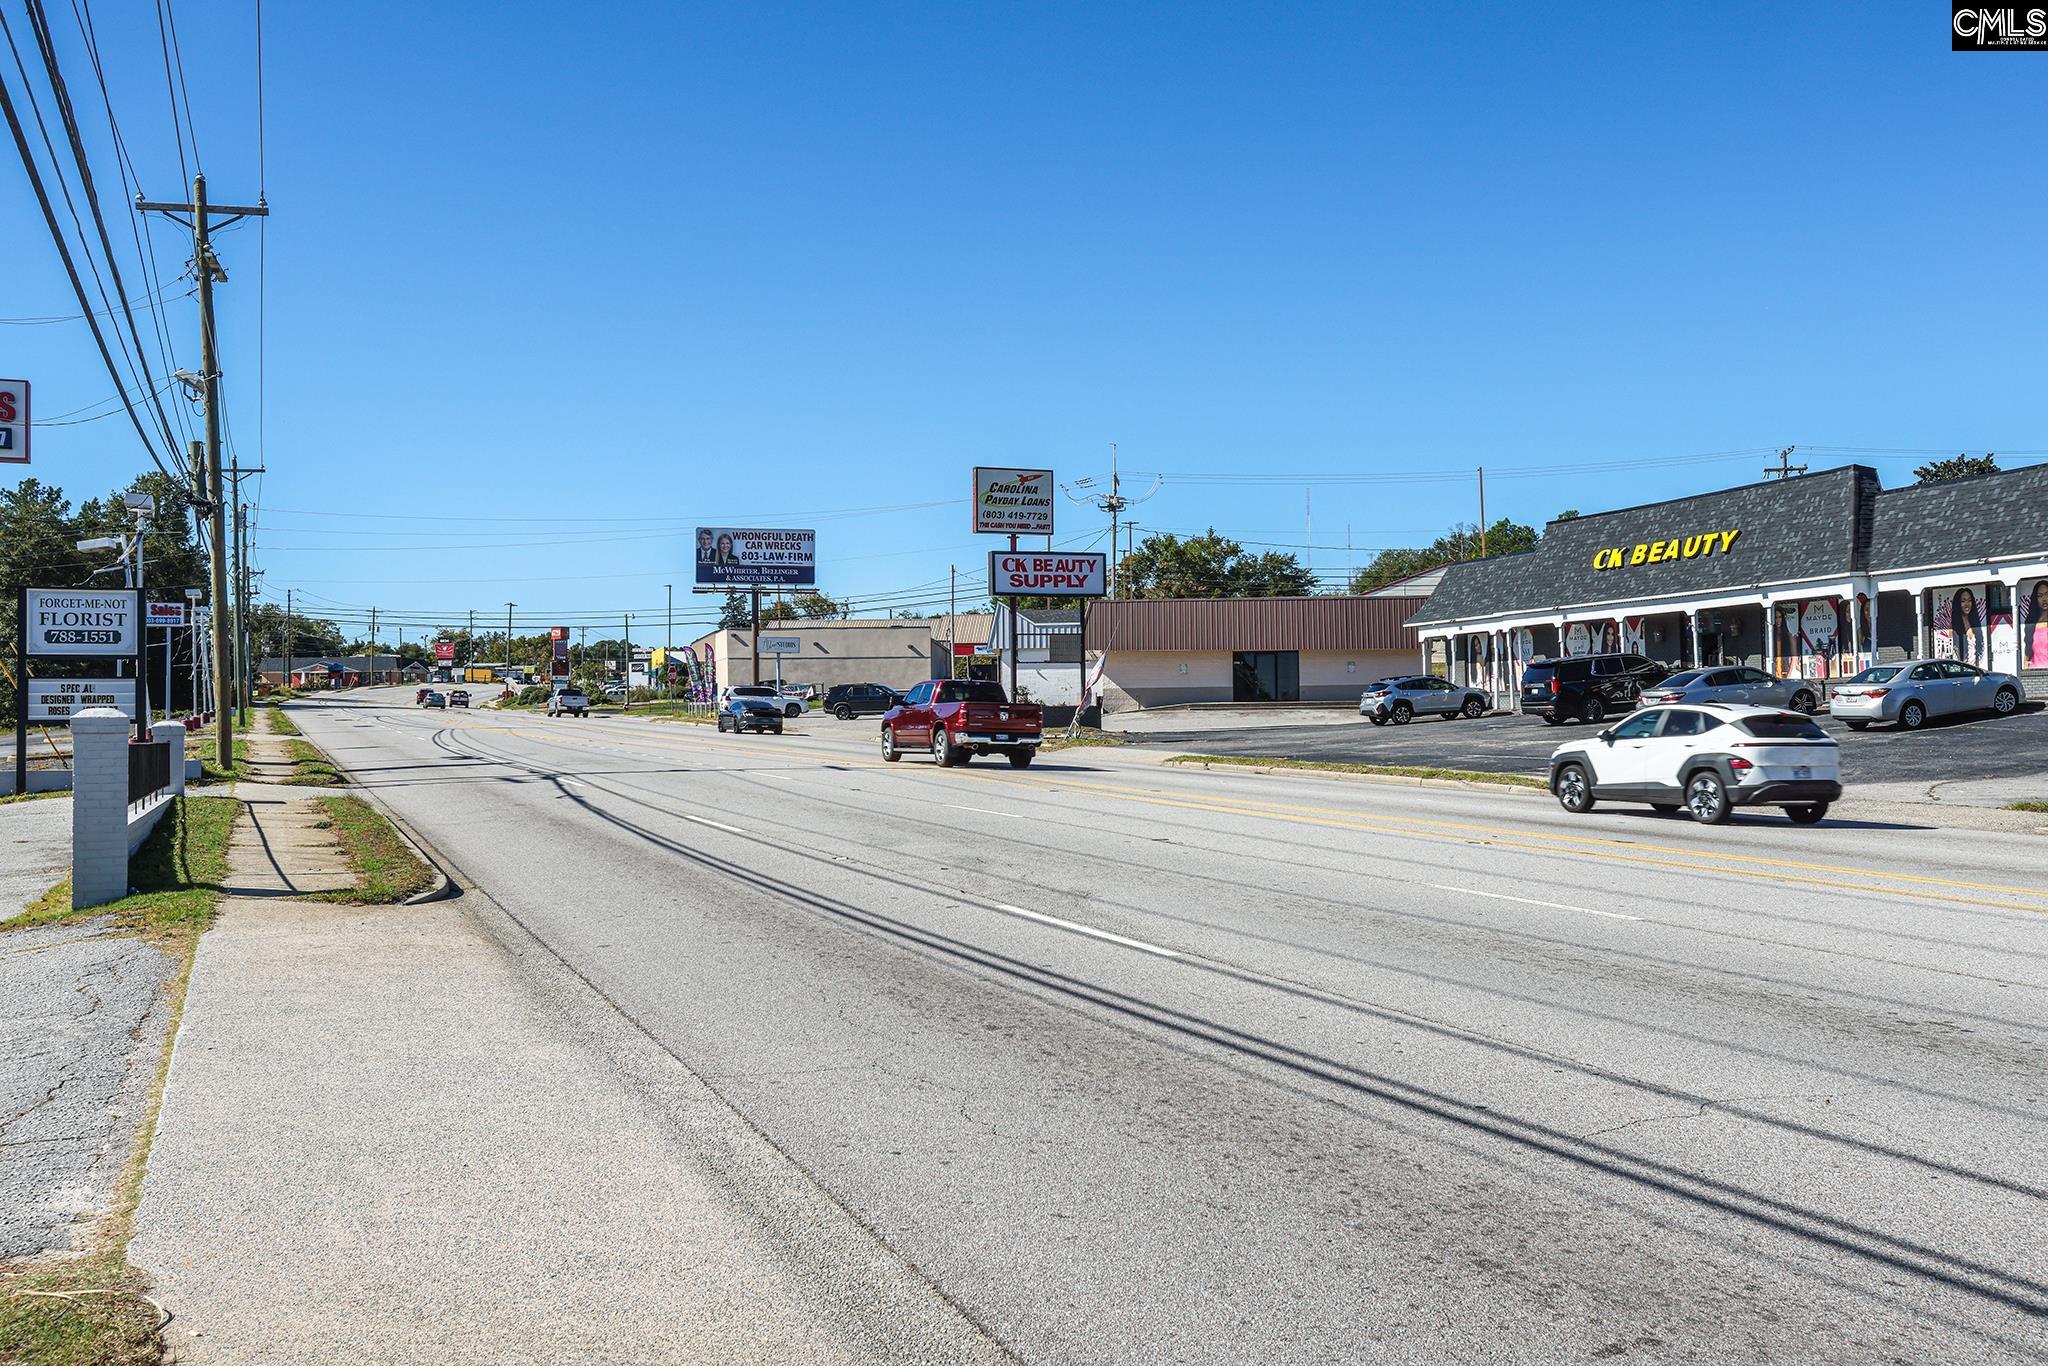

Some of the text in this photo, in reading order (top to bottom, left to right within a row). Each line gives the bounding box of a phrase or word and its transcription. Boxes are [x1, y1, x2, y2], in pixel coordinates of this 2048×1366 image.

[990, 482, 1038, 494] CAROLINA
[985, 495, 1050, 506] PAYDAY LOANS
[983, 511, 1048, 520] (803) 419-7729
[732, 532, 813, 541] WRONGFUL DEATH
[745, 542, 801, 551] CAR WRECKS
[1593, 530, 1740, 571] CK BEAUTY
[741, 552, 812, 561] 803-LAW-FIRM
[1002, 558, 1097, 573] CK BEAUTY
[761, 567, 799, 575] BELLINGER
[1009, 574, 1089, 588] SUPPLY
[40, 598, 127, 609] FORGET-ME-NOT
[40, 612, 127, 627] FLORIST
[1809, 627, 1832, 635] BRAID
[50, 631, 115, 643] 788-1551
[41, 695, 114, 704] DESIGNER WRAPPED
[48, 706, 70, 716] ROSES
